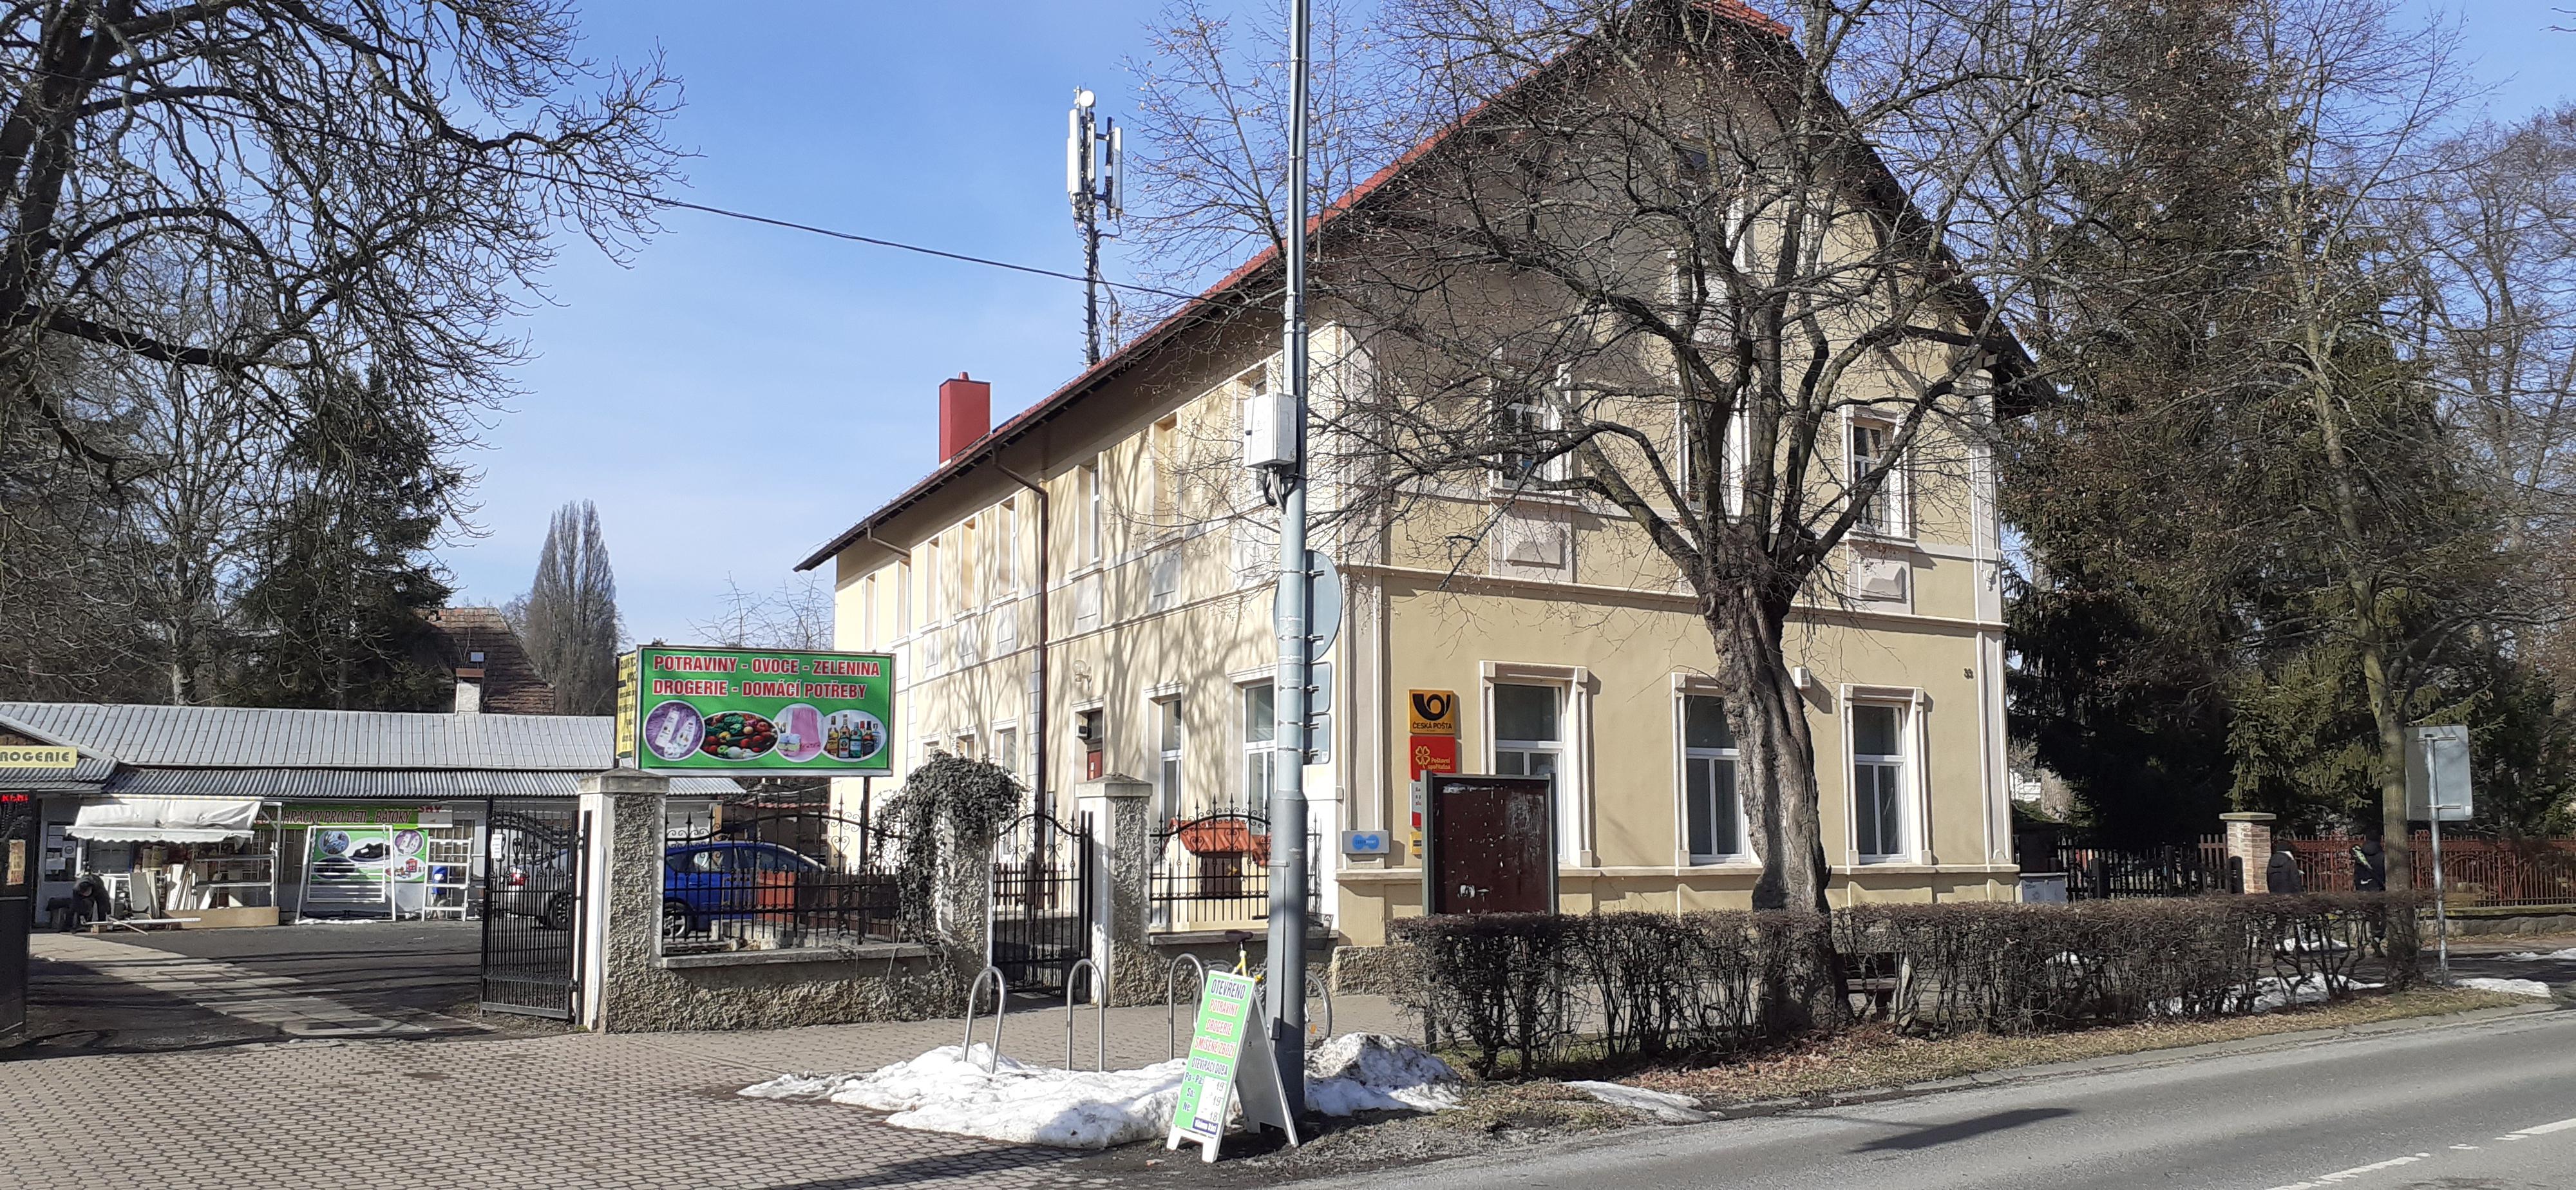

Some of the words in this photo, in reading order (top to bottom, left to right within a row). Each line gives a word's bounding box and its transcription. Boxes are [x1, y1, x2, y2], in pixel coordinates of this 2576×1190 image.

[654, 655, 737, 672] POTRAVINY
[752, 657, 799, 674] OVOCE
[813, 659, 880, 676] ZELENINA
[653, 679, 728, 695] DROGERIE
[743, 679, 801, 697] DOMÁCÍ
[804, 680, 867, 699] POTŘEBY
[324, 810, 344, 823] PRO
[1211, 979, 1246, 999] OTEVŘENO
[1209, 999, 1239, 1016] POTRAVINY
[1206, 1019, 1233, 1035] DROGERIE
